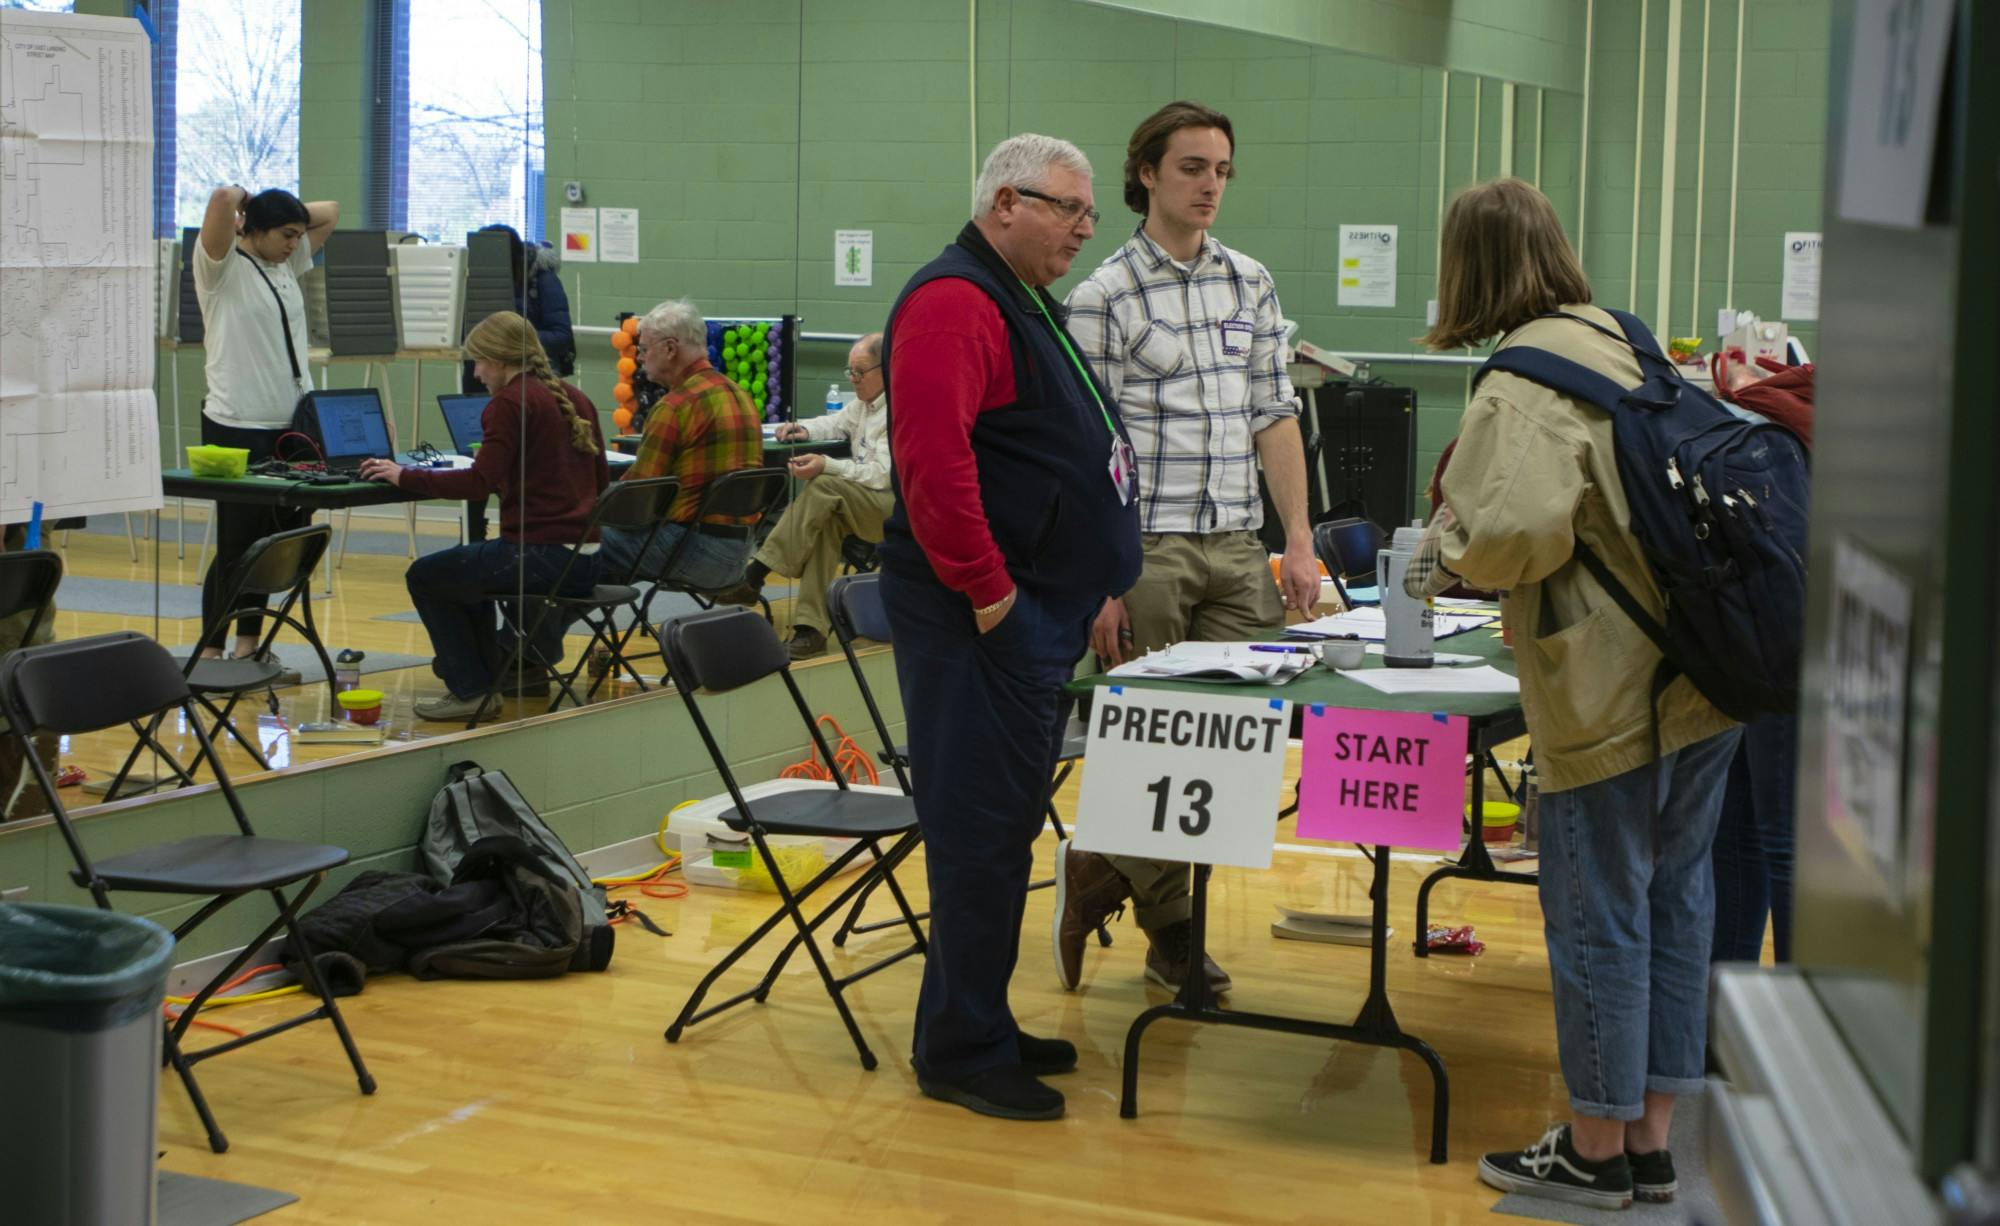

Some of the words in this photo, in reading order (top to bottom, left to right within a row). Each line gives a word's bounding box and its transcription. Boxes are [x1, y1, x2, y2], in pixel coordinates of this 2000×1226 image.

[1098, 704, 1282, 753] PRECINCT
[1335, 732, 1430, 766] START
[1147, 775, 1213, 837] 13
[1340, 778, 1419, 812] HERE
